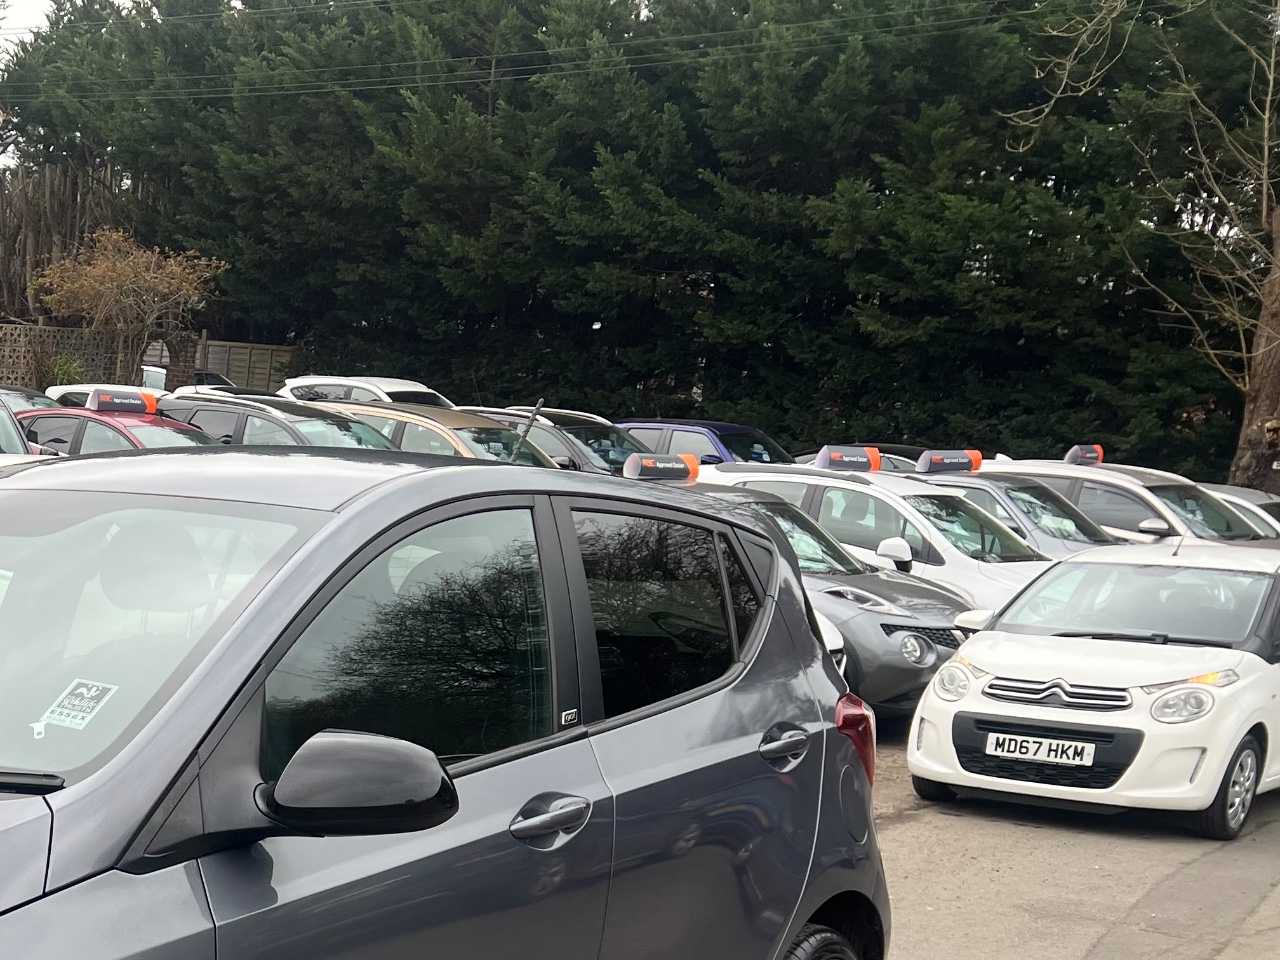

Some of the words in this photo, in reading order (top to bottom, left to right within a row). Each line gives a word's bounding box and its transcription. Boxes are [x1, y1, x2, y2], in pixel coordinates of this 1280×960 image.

[49, 709, 88, 721] ESSEX
[994, 736, 1043, 757] MD67
[1046, 742, 1086, 761] HKM
